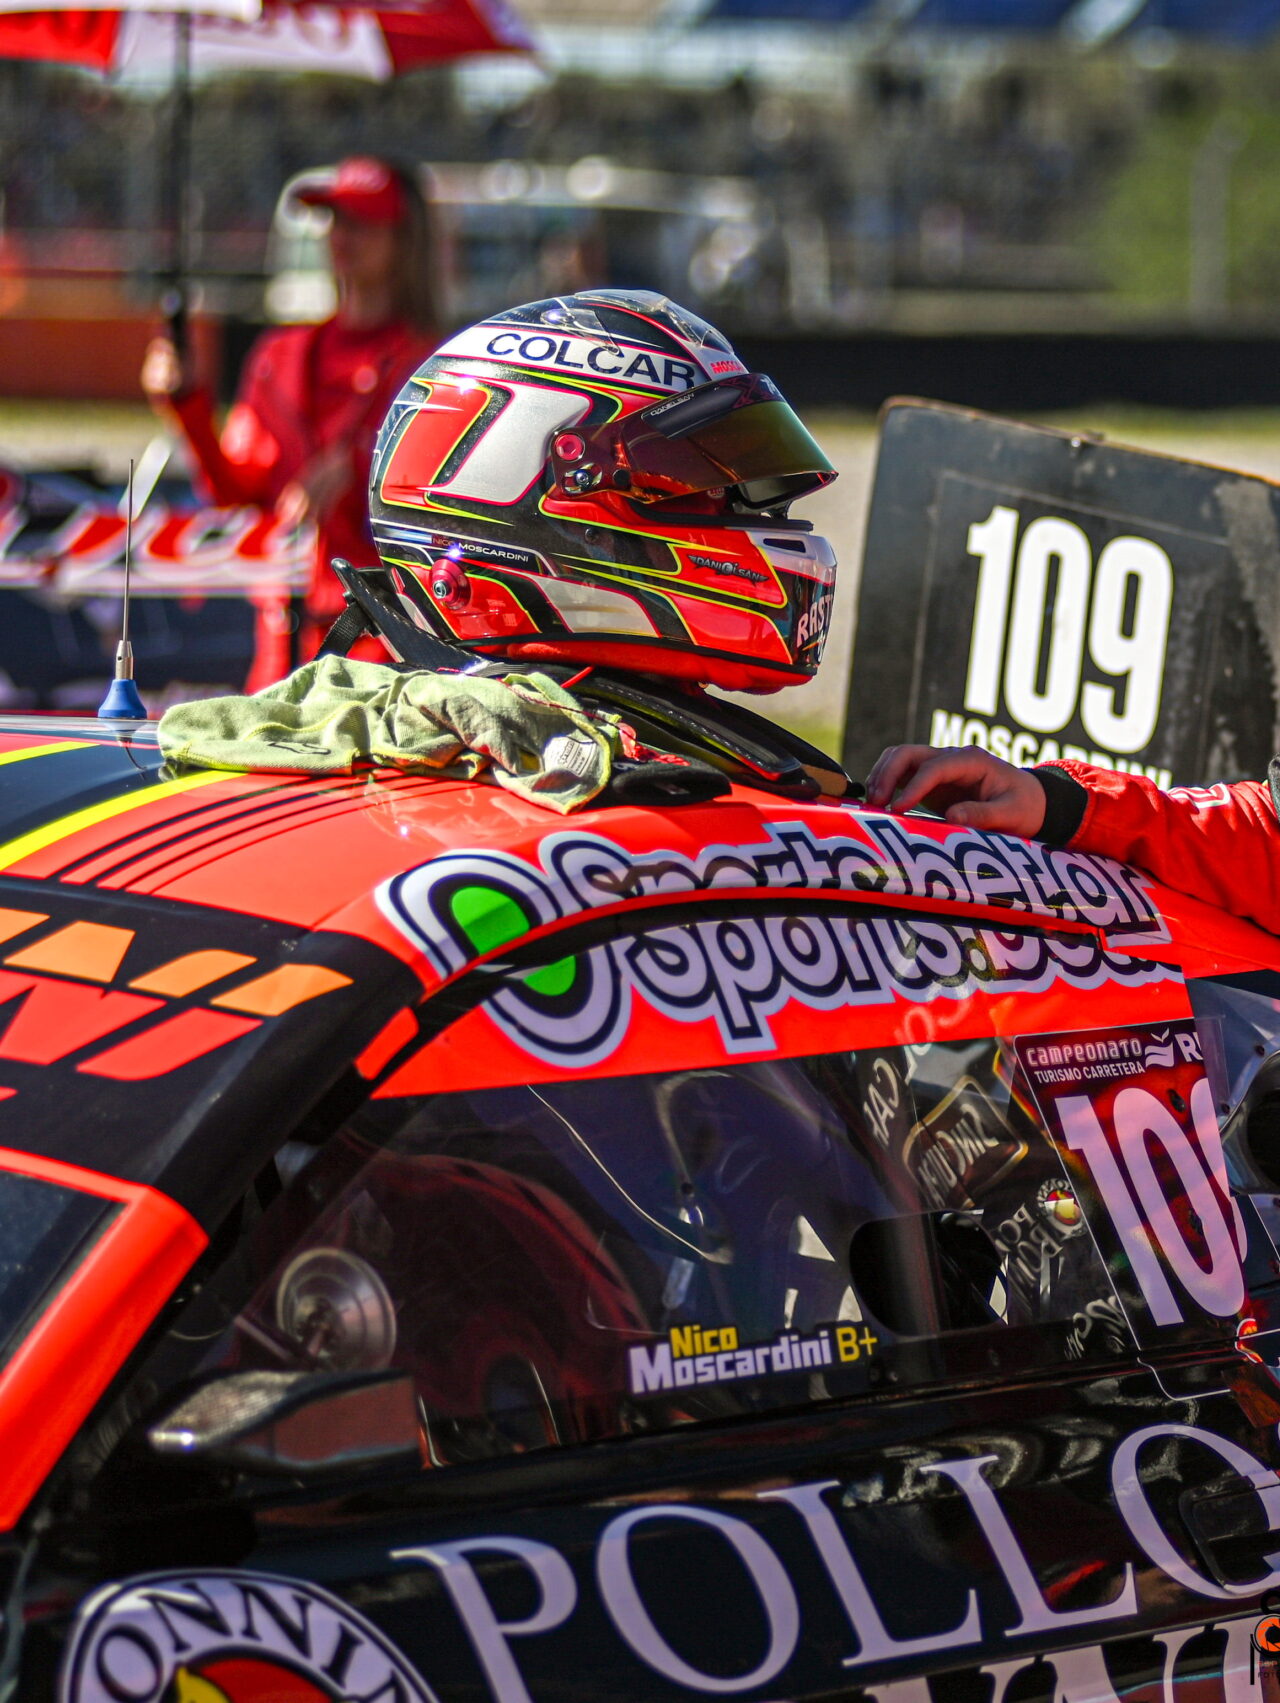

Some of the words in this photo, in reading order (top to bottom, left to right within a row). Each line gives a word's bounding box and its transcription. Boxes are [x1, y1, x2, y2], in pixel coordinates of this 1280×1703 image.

[486, 333, 697, 388] COLCAR
[458, 542, 529, 562] MOSCARDINI
[964, 505, 1173, 754] 109
[1034, 1067, 1082, 1084] TURISMO
[1083, 1061, 1146, 1079] CARRETERA
[628, 1331, 833, 1394] Moscardini
[836, 1326, 878, 1363] B+
[670, 1325, 738, 1358] Nico
